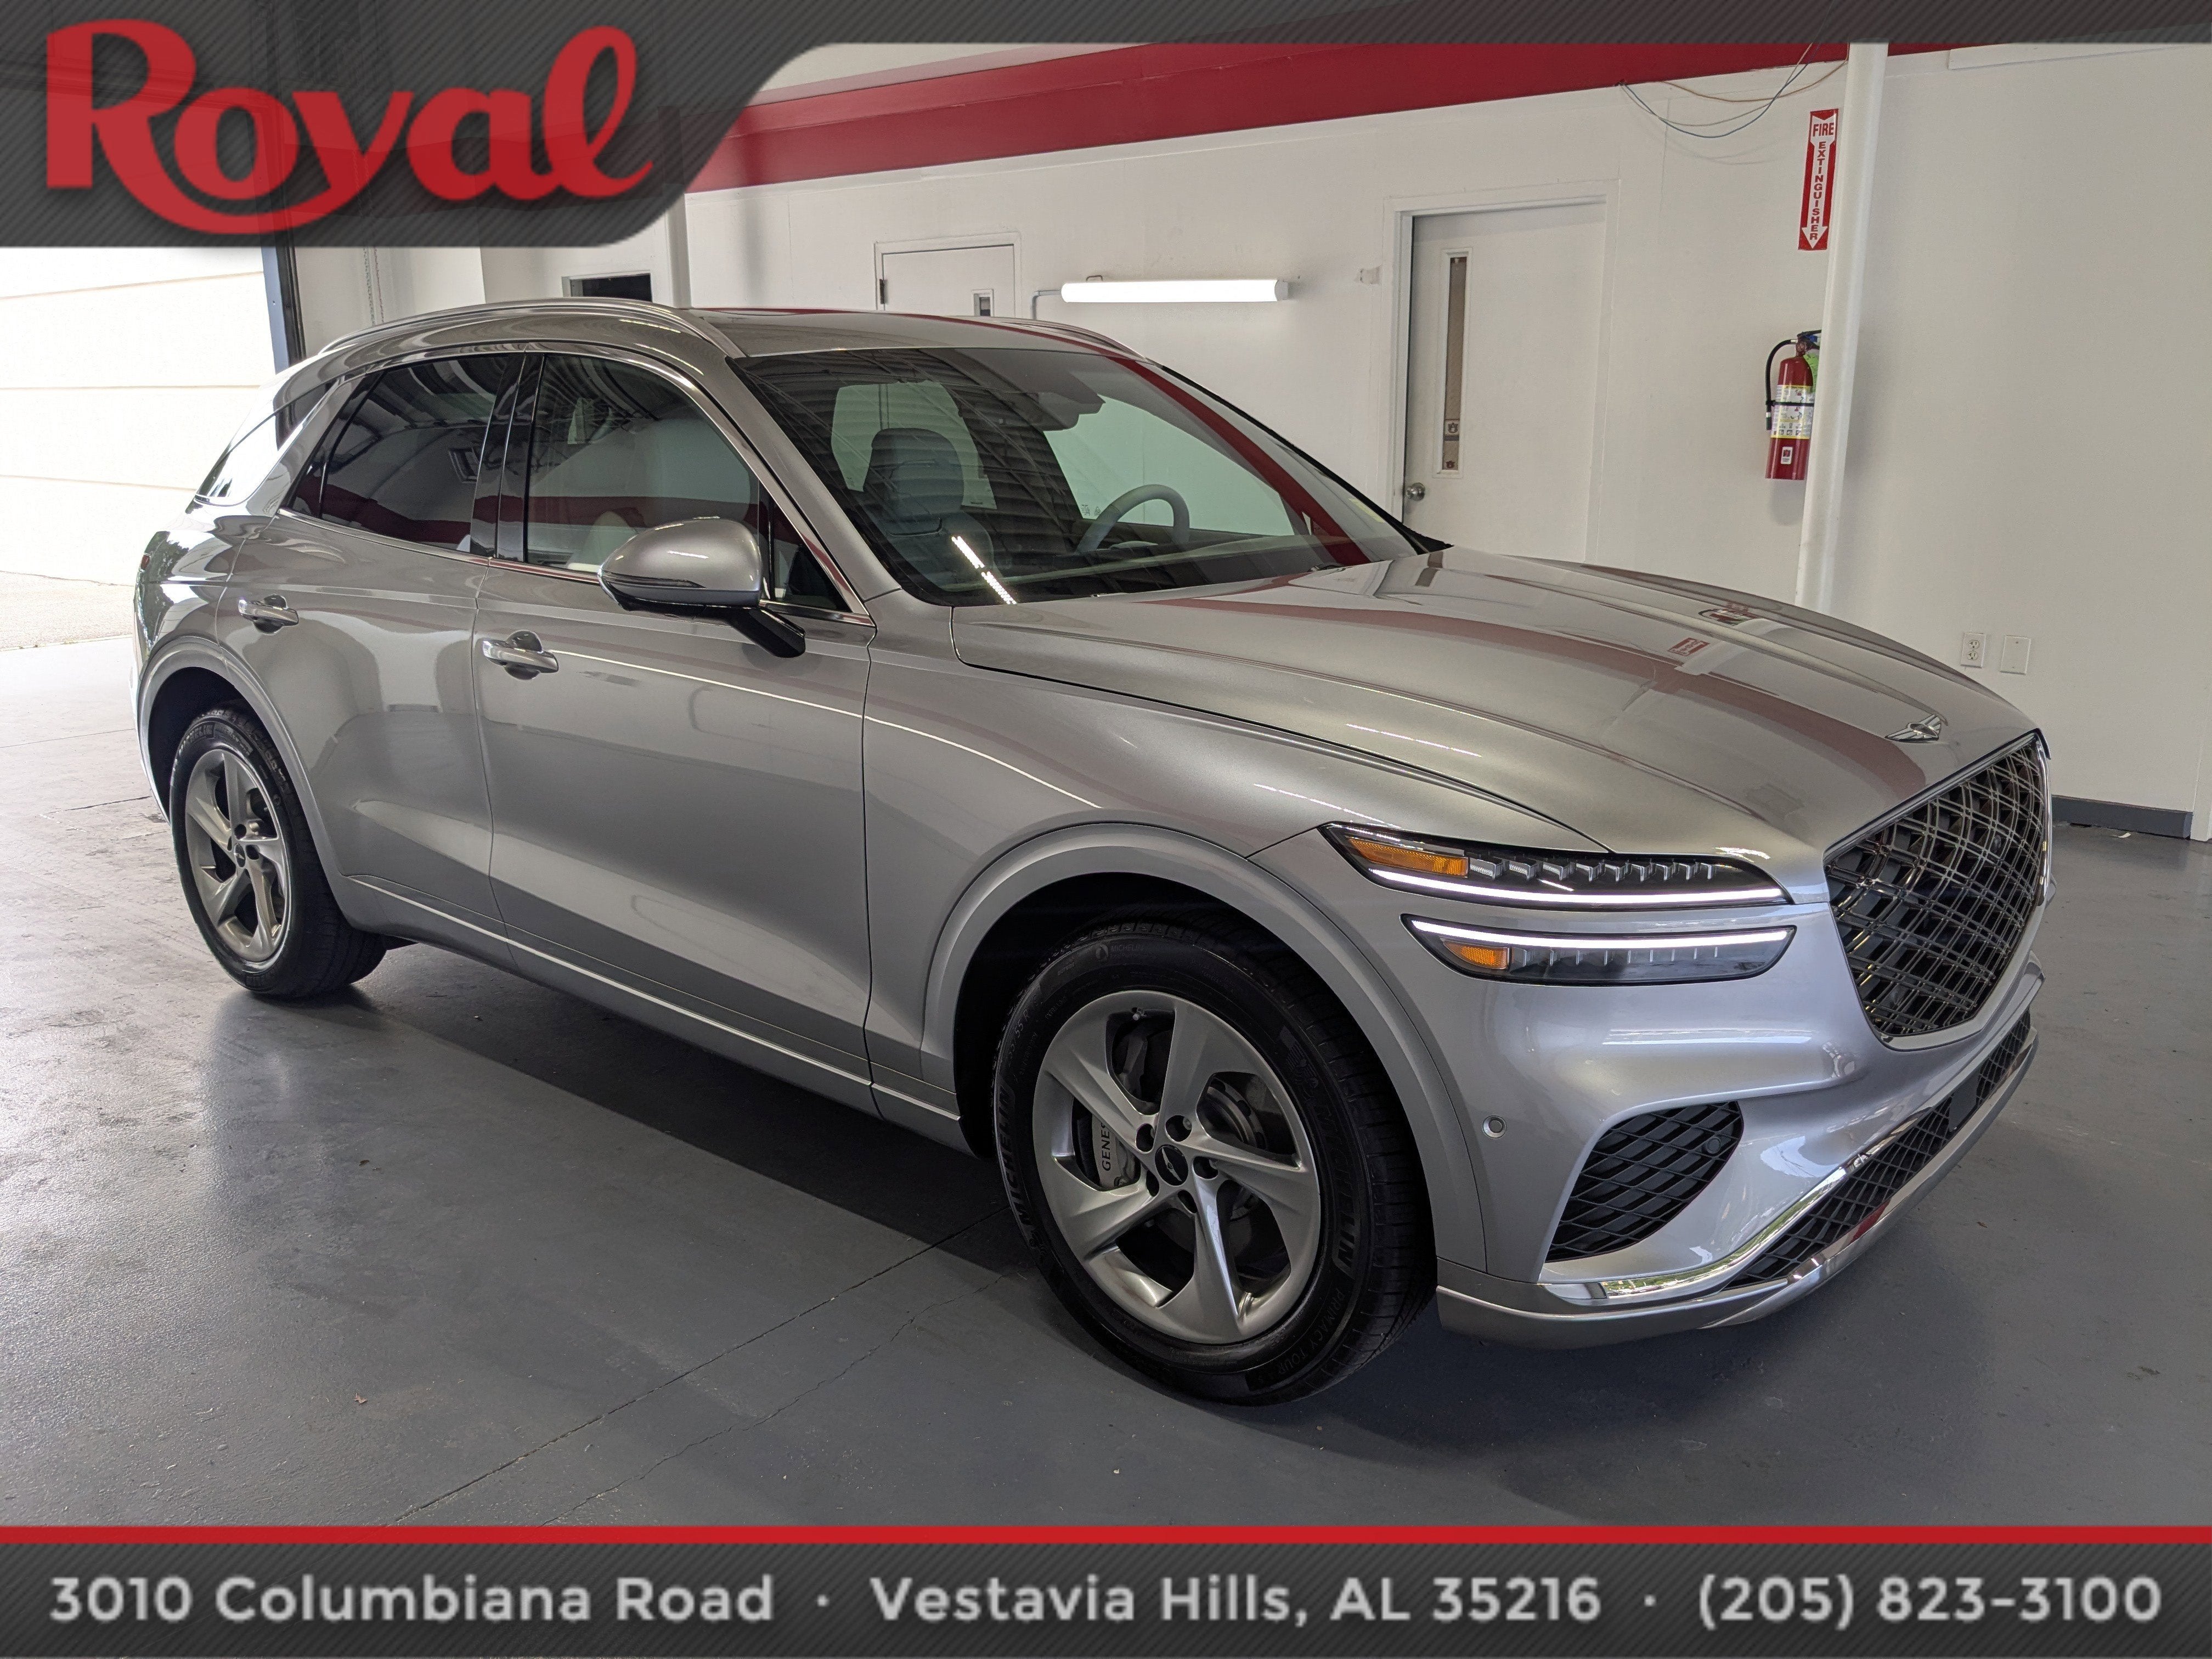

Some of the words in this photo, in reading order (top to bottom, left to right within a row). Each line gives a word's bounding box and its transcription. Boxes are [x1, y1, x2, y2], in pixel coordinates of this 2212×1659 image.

[1813, 122, 1835, 137] FIRE
[1809, 141, 1827, 240] EXTINGUISHER
[998, 1084, 1031, 1225] MICHELIN
[1309, 1288, 1345, 1350] PRIMACY
[1278, 1347, 1307, 1374] TOUR
